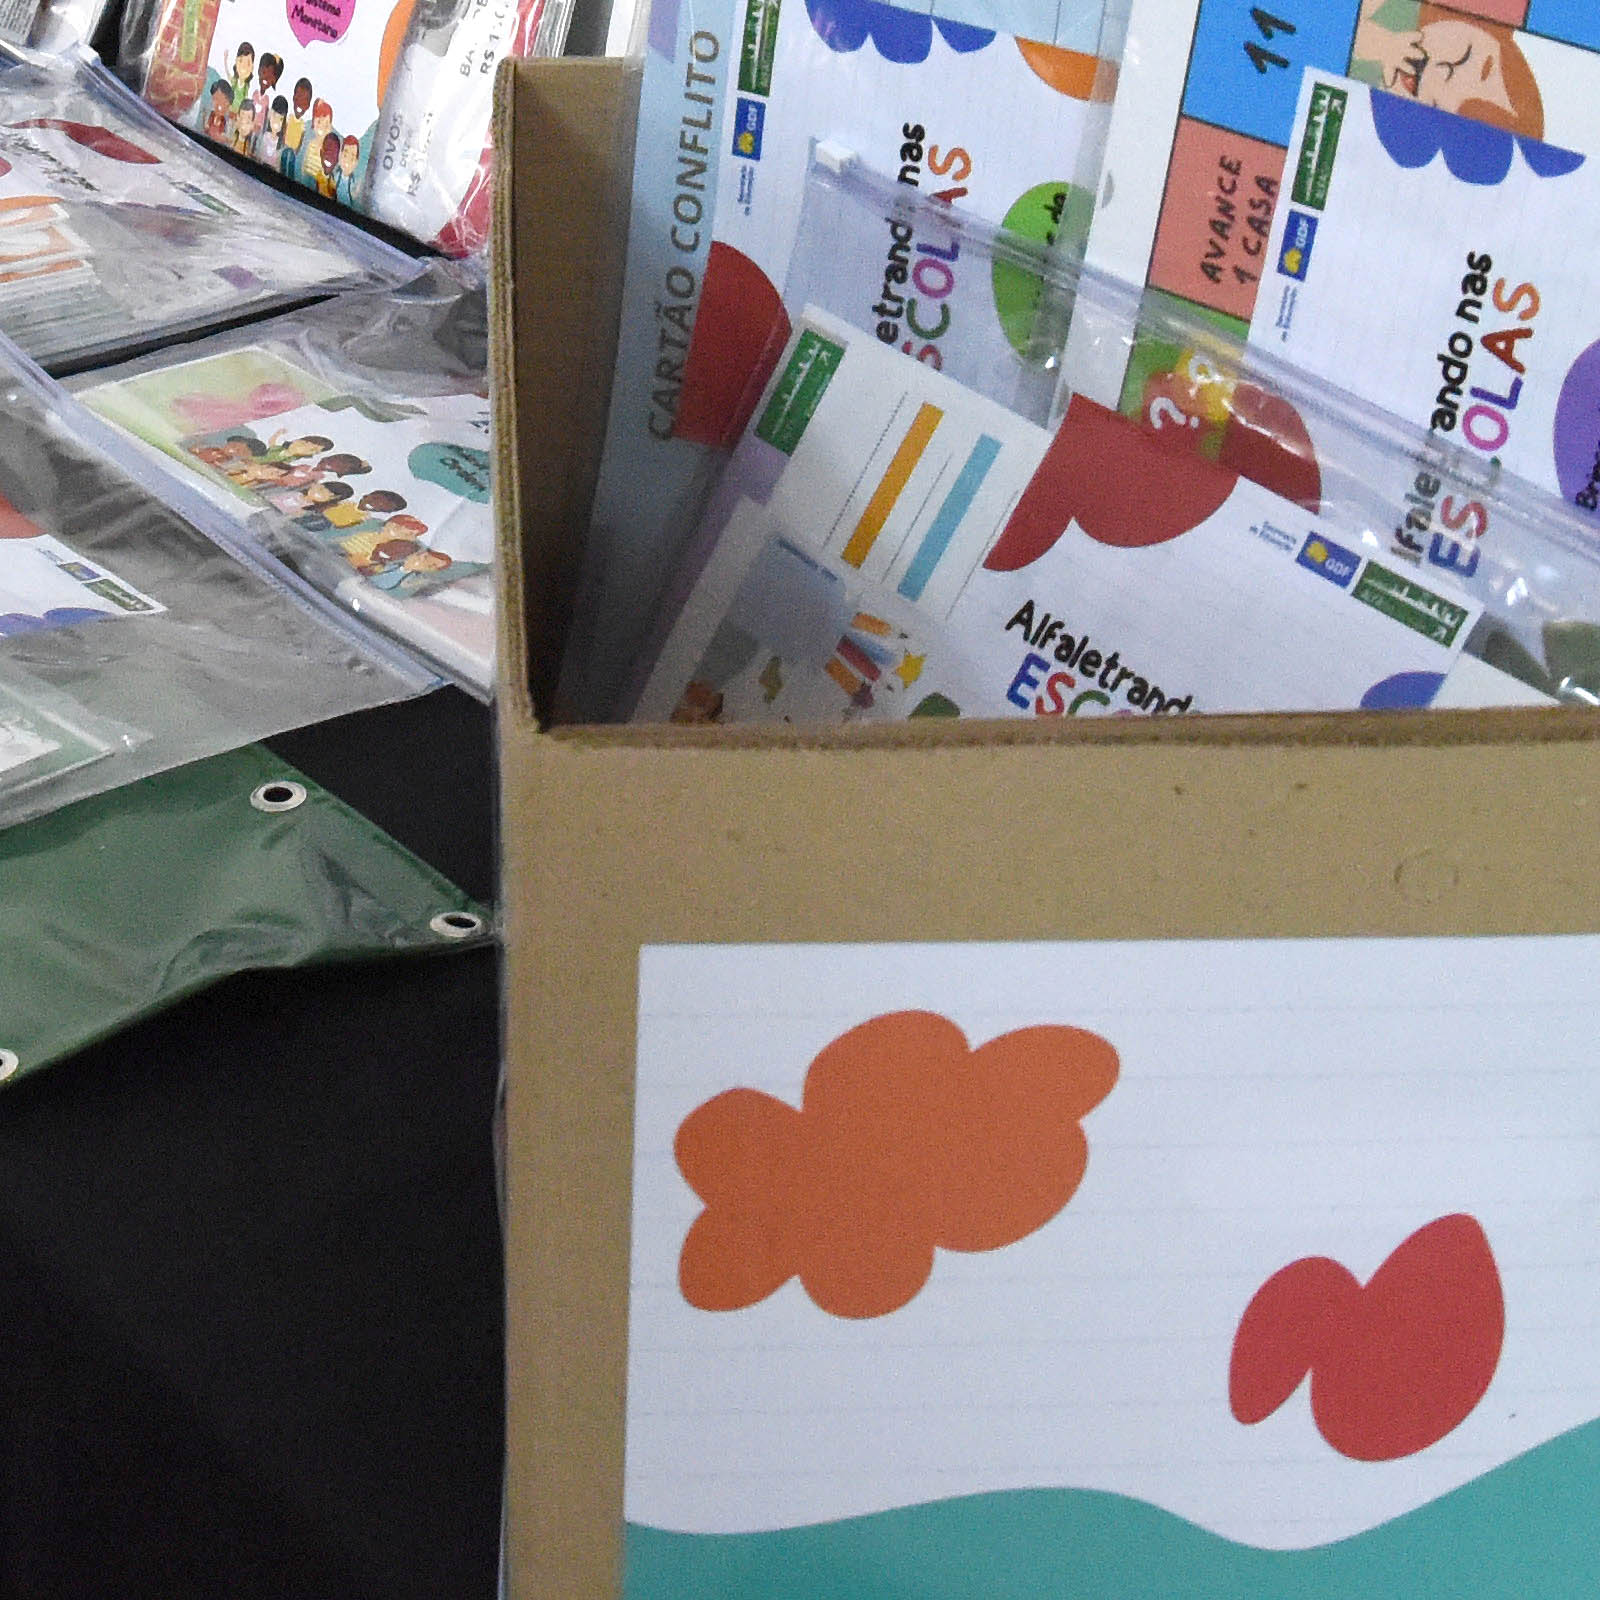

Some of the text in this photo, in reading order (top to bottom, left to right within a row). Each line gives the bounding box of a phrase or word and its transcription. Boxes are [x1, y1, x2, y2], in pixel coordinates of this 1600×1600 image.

[1241, 6, 1300, 76] 11
[897, 121, 926, 188] nas
[648, 29, 721, 442] CARTÃO CONFLITO
[1200, 154, 1242, 285] AVANCE
[1233, 175, 1279, 285] 1 CASA
[1455, 250, 1493, 325] nas
[1427, 276, 1542, 579] ESOLAS
[1323, 556, 1350, 578] GDF
[1005, 599, 1198, 715] Alfaletrand
